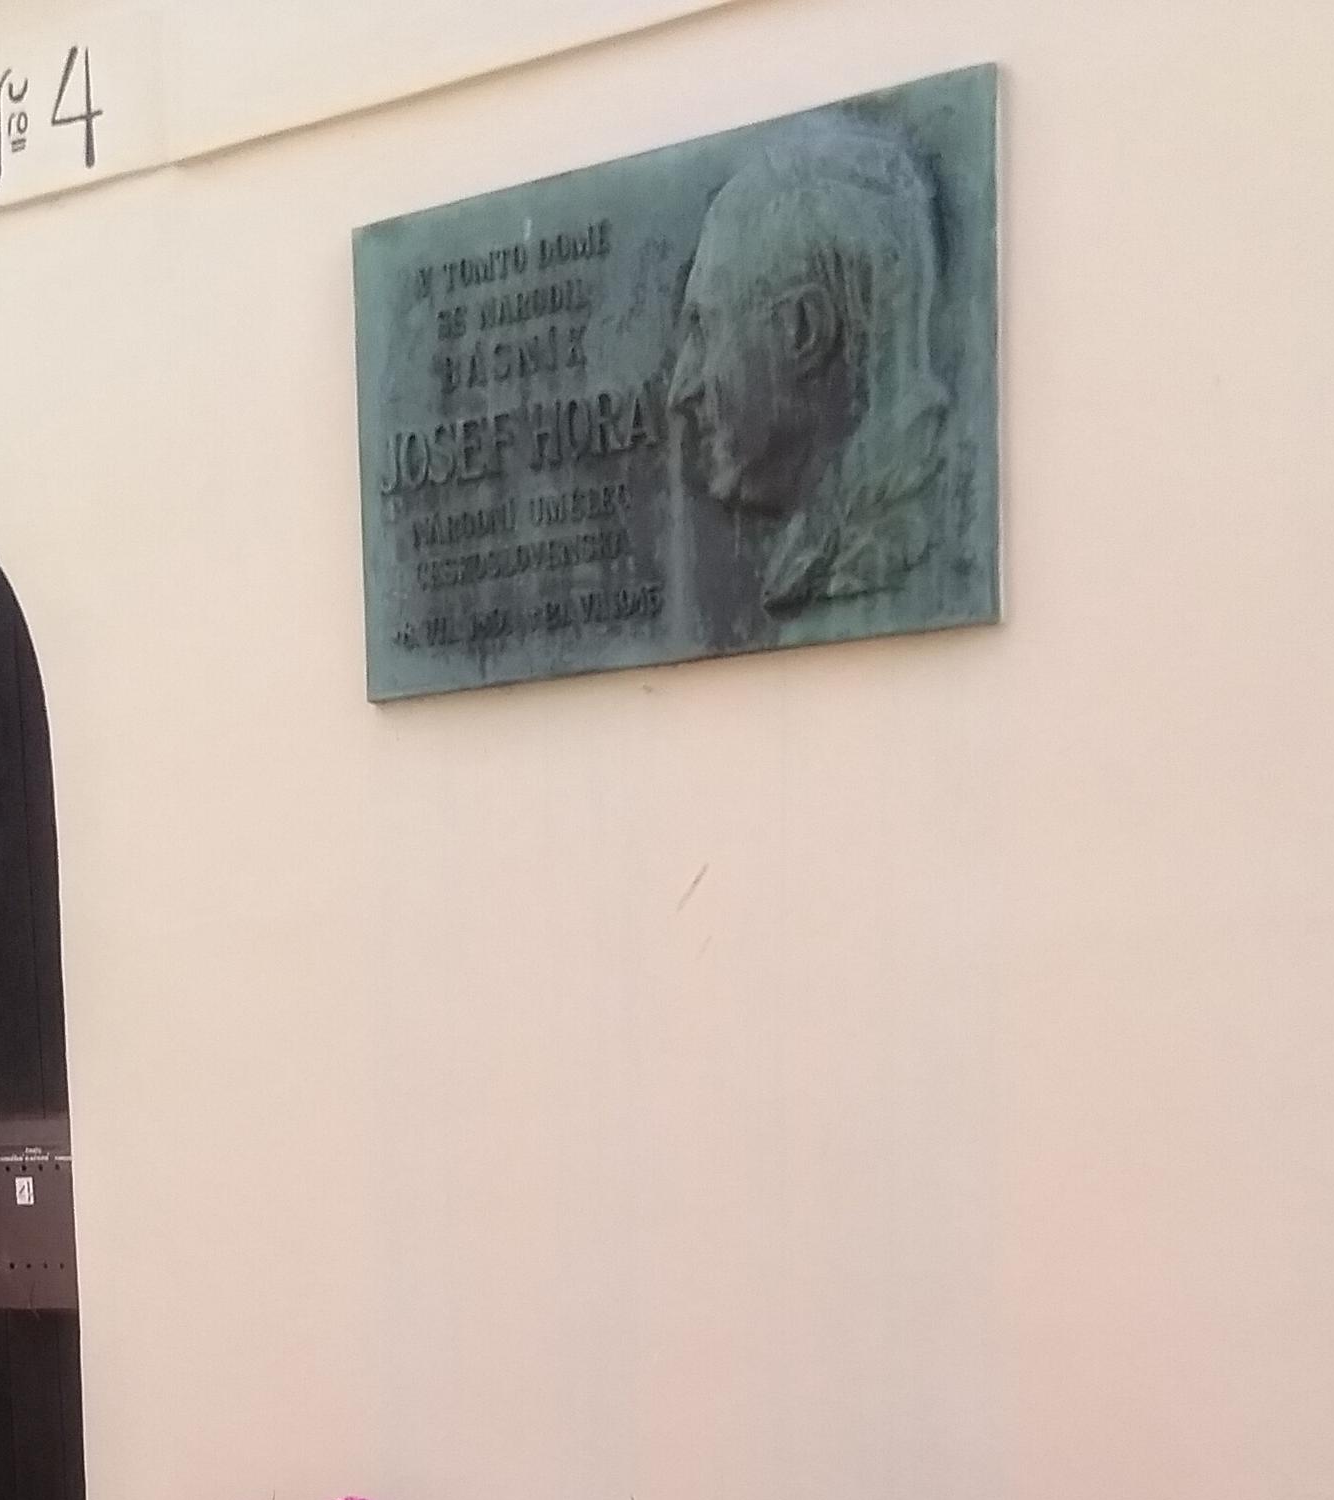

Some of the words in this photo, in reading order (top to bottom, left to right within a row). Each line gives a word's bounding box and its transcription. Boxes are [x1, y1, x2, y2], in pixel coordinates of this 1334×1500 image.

[50, 46, 104, 169] 4
[443, 246, 528, 294] TOMTO
[381, 412, 513, 497] JOSEF
[527, 387, 662, 473] HORA
